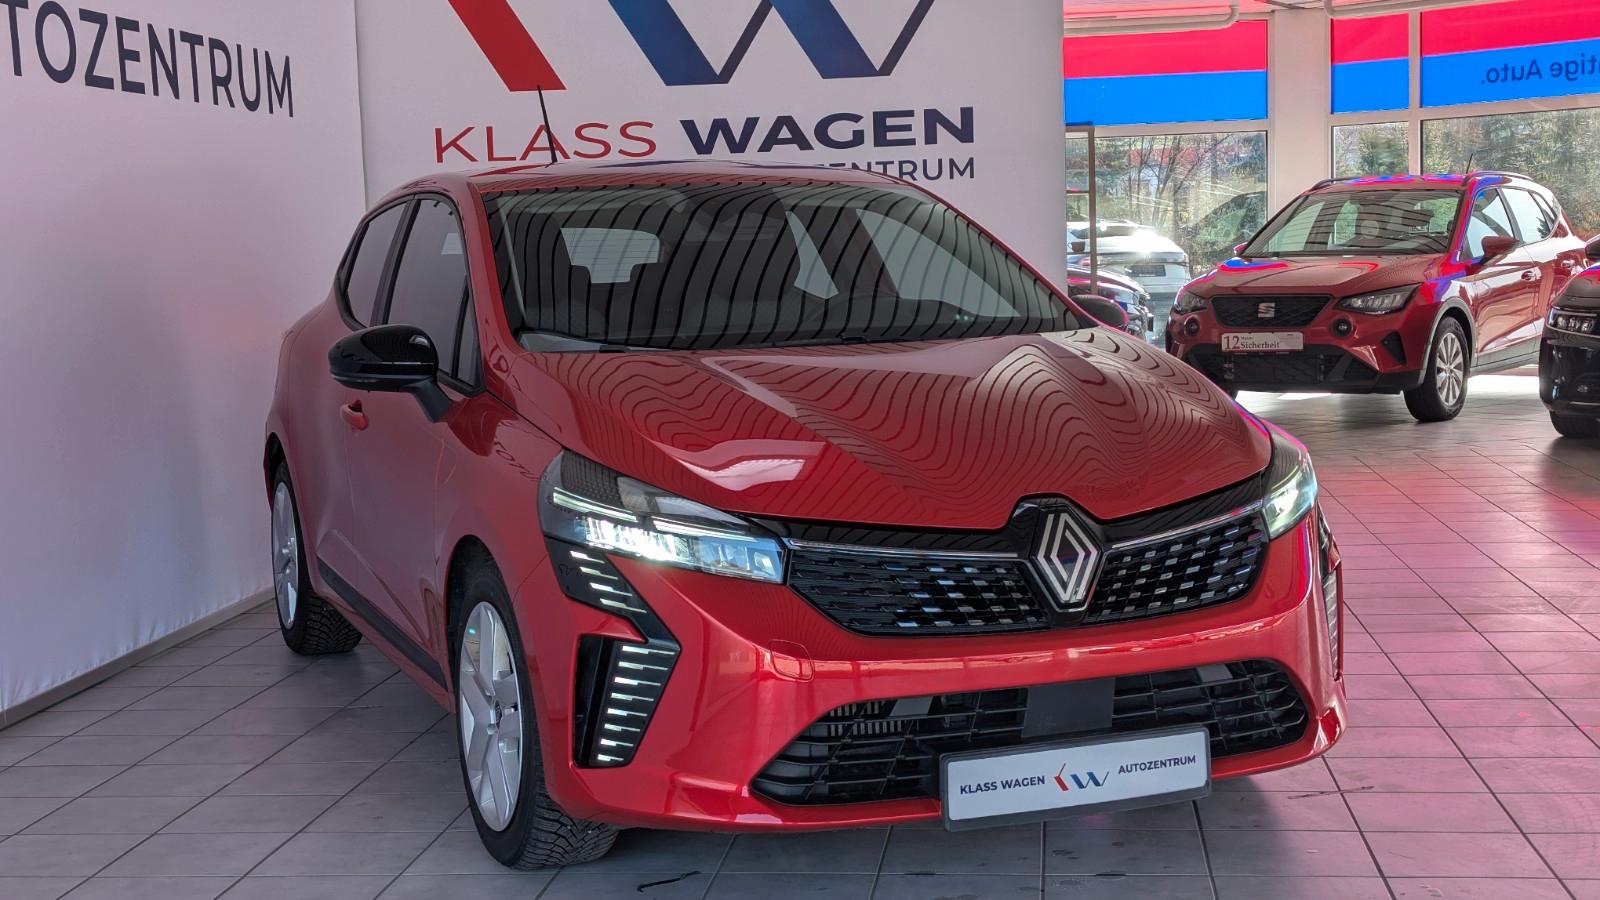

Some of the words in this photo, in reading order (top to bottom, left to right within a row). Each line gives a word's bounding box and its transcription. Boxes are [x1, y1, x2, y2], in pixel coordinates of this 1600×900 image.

[435, 121, 657, 164] KLASS
[680, 107, 974, 155] WAGEN
[1224, 335, 1240, 350] 12
[1240, 341, 1280, 349] Sicherheit
[960, 782, 998, 795] KLASS
[1000, 775, 1046, 790] WAGEN
[1118, 755, 1196, 775] AUTOZENTRUM
